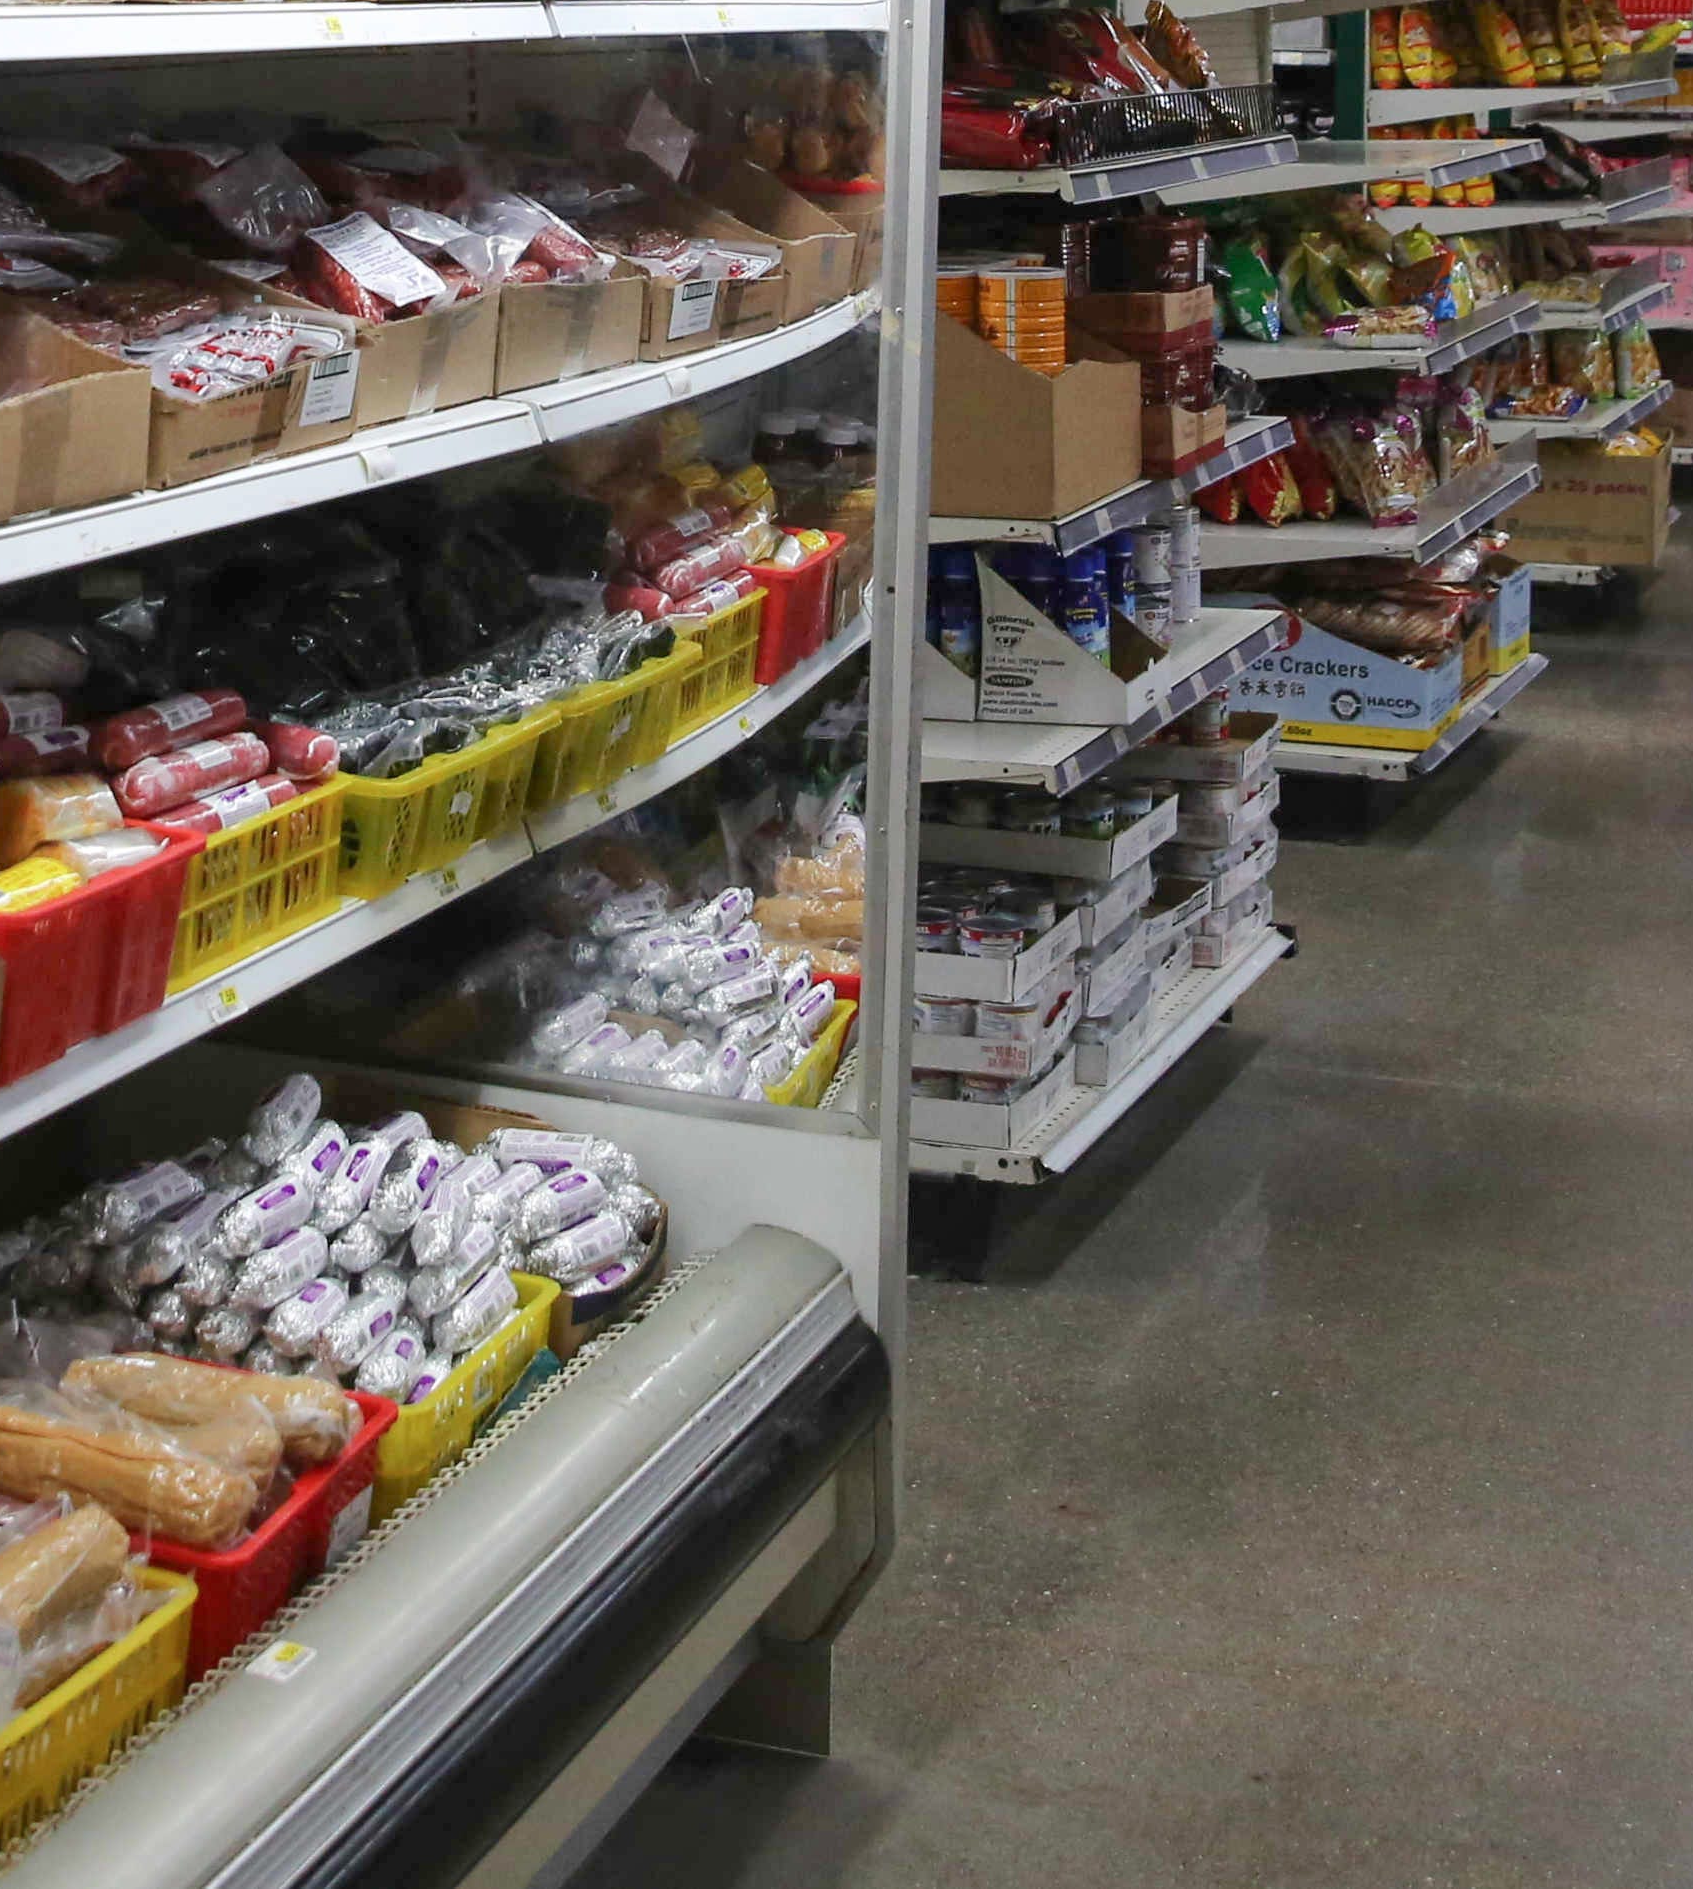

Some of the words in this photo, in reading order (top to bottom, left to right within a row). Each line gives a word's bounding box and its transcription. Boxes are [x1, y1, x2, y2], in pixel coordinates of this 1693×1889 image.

[992, 625, 1026, 634] Farms
[1246, 658, 1274, 673] ce
[1280, 655, 1370, 680] Crackers
[1366, 695, 1414, 710] HACCP
